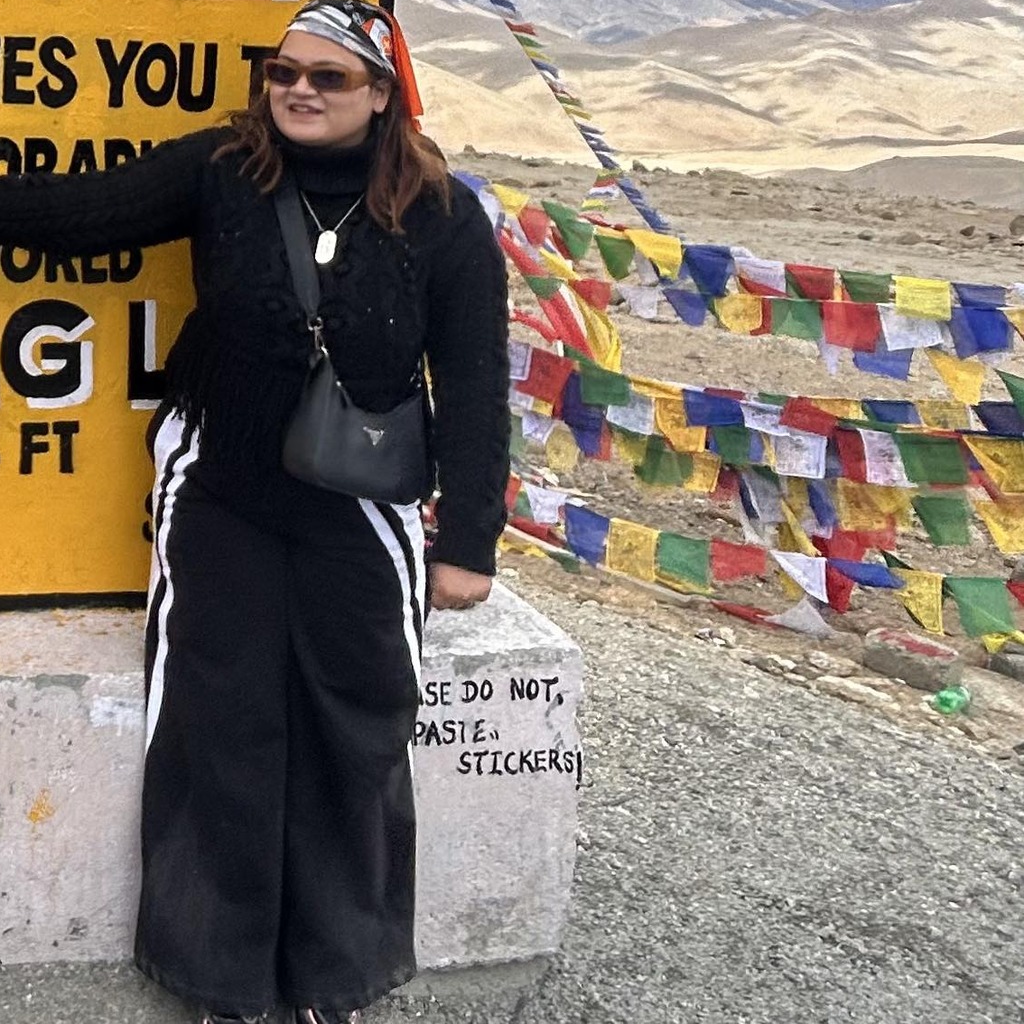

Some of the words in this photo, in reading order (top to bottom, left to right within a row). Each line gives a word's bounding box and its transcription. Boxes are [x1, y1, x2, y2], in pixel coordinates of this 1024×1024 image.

[96, 38, 218, 112] YOU
[127, 299, 167, 409] L
[19, 420, 80, 475] FT
[418, 681, 452, 707] SE
[461, 679, 493, 703] DO
